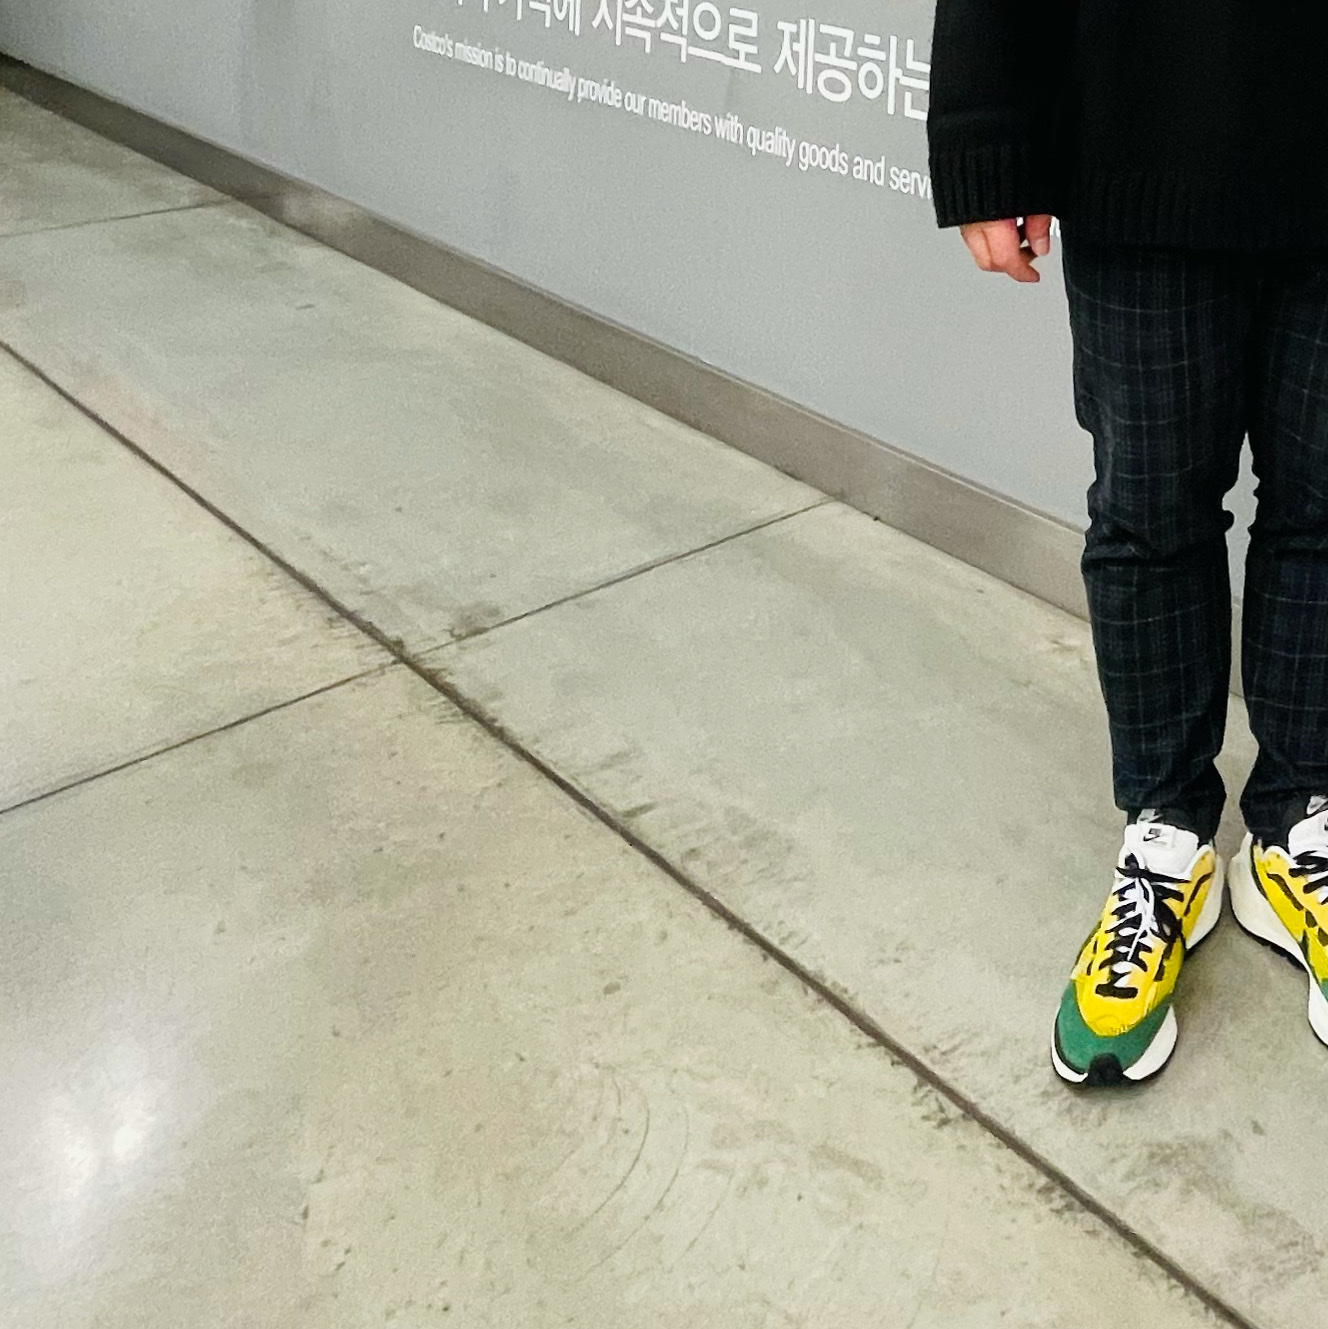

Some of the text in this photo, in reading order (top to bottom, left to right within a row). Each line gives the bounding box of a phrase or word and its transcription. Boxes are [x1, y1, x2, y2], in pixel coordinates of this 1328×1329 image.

[412, 24, 455, 58] Costco's
[454, 38, 494, 71] mission
[494, 46, 505, 73] is
[506, 52, 517, 77] to
[518, 60, 577, 102] continually
[577, 78, 623, 109] provide
[624, 90, 646, 116] our
[647, 97, 713, 136] members
[714, 111, 745, 145] with
[746, 125, 797, 167] quality
[798, 141, 850, 176] goods
[852, 155, 885, 187] and
[774, 17, 932, 122] 제공하는
